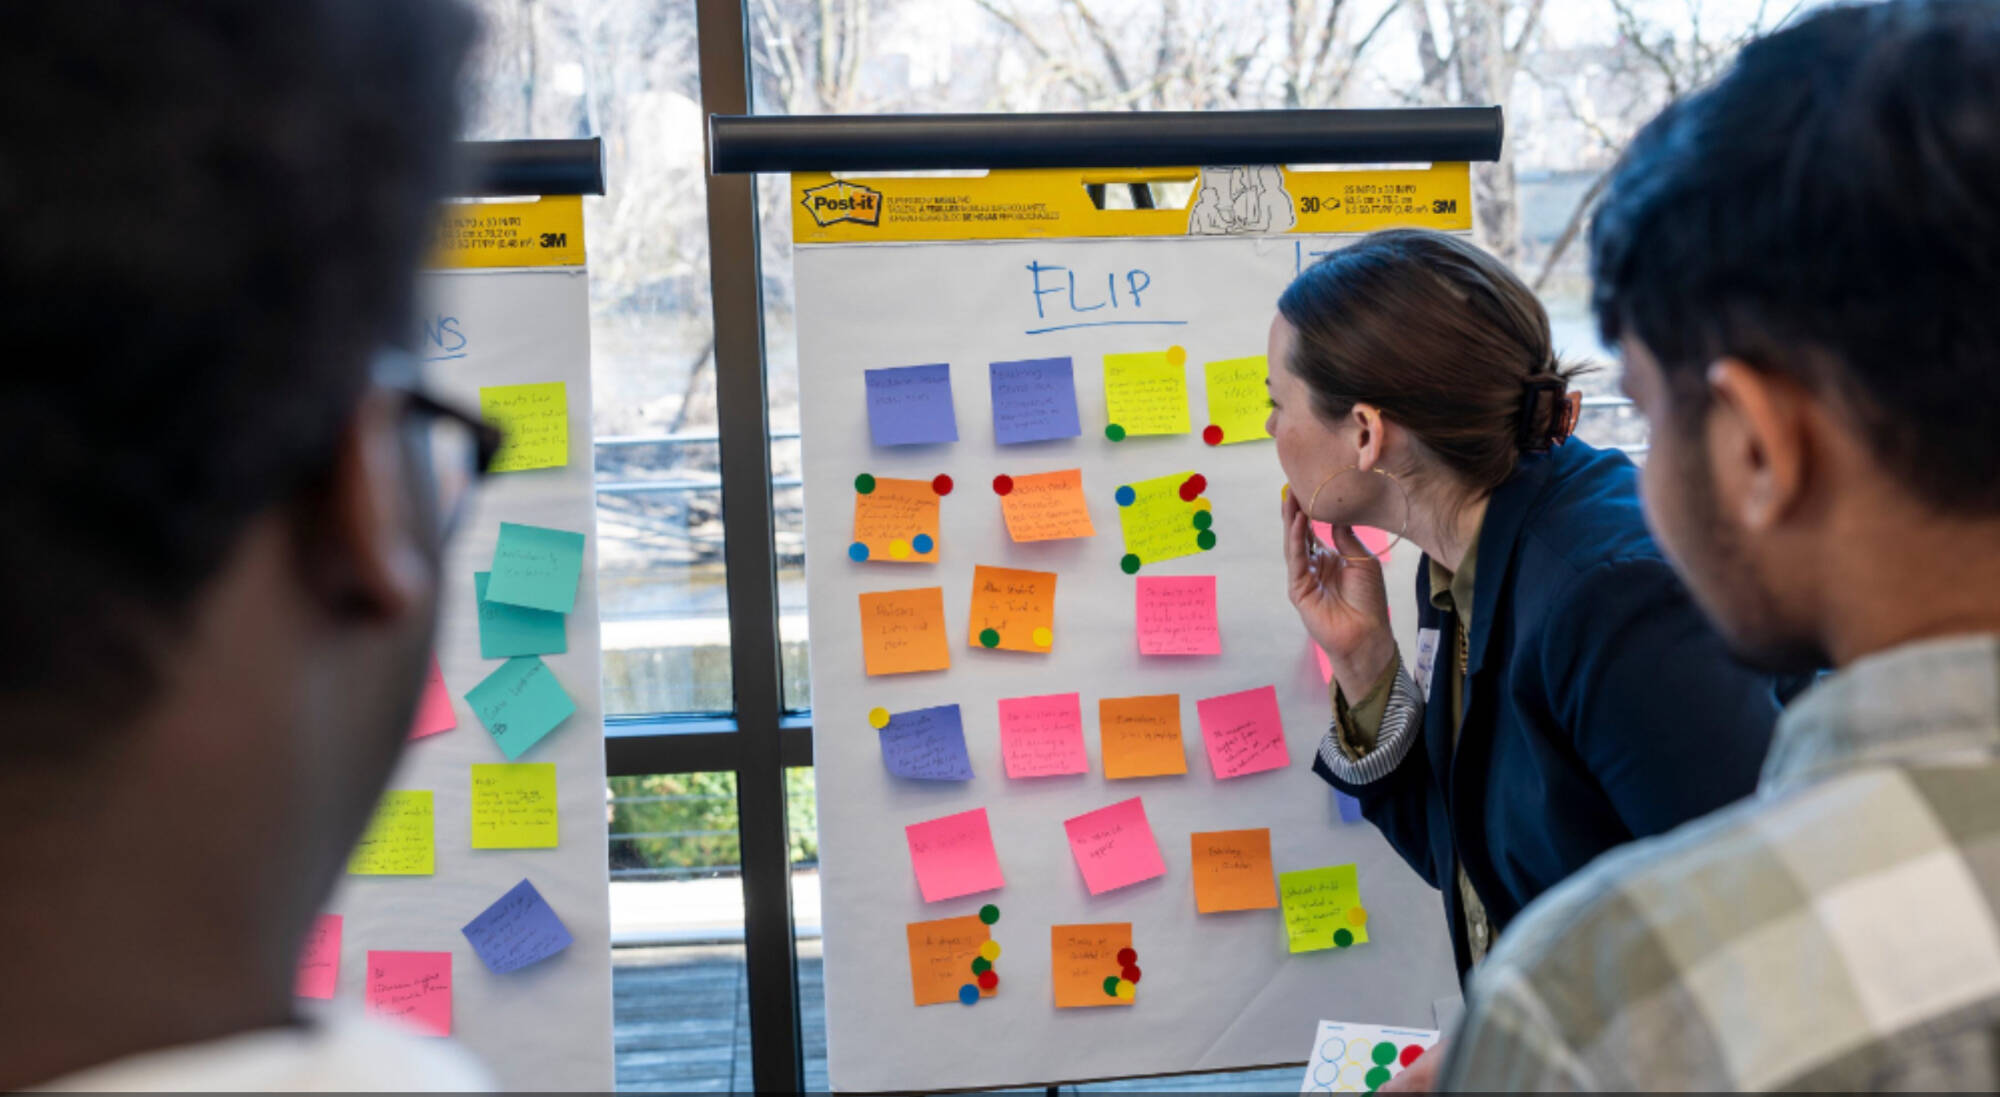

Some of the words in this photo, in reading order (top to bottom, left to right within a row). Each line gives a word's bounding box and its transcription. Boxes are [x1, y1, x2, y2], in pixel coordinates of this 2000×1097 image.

[813, 195, 875, 212] Post-it
[1300, 197, 1320, 214] 30
[1432, 199, 1457, 214] 3M
[539, 233, 567, 248] 3M
[1026, 260, 1151, 319] FLIP
